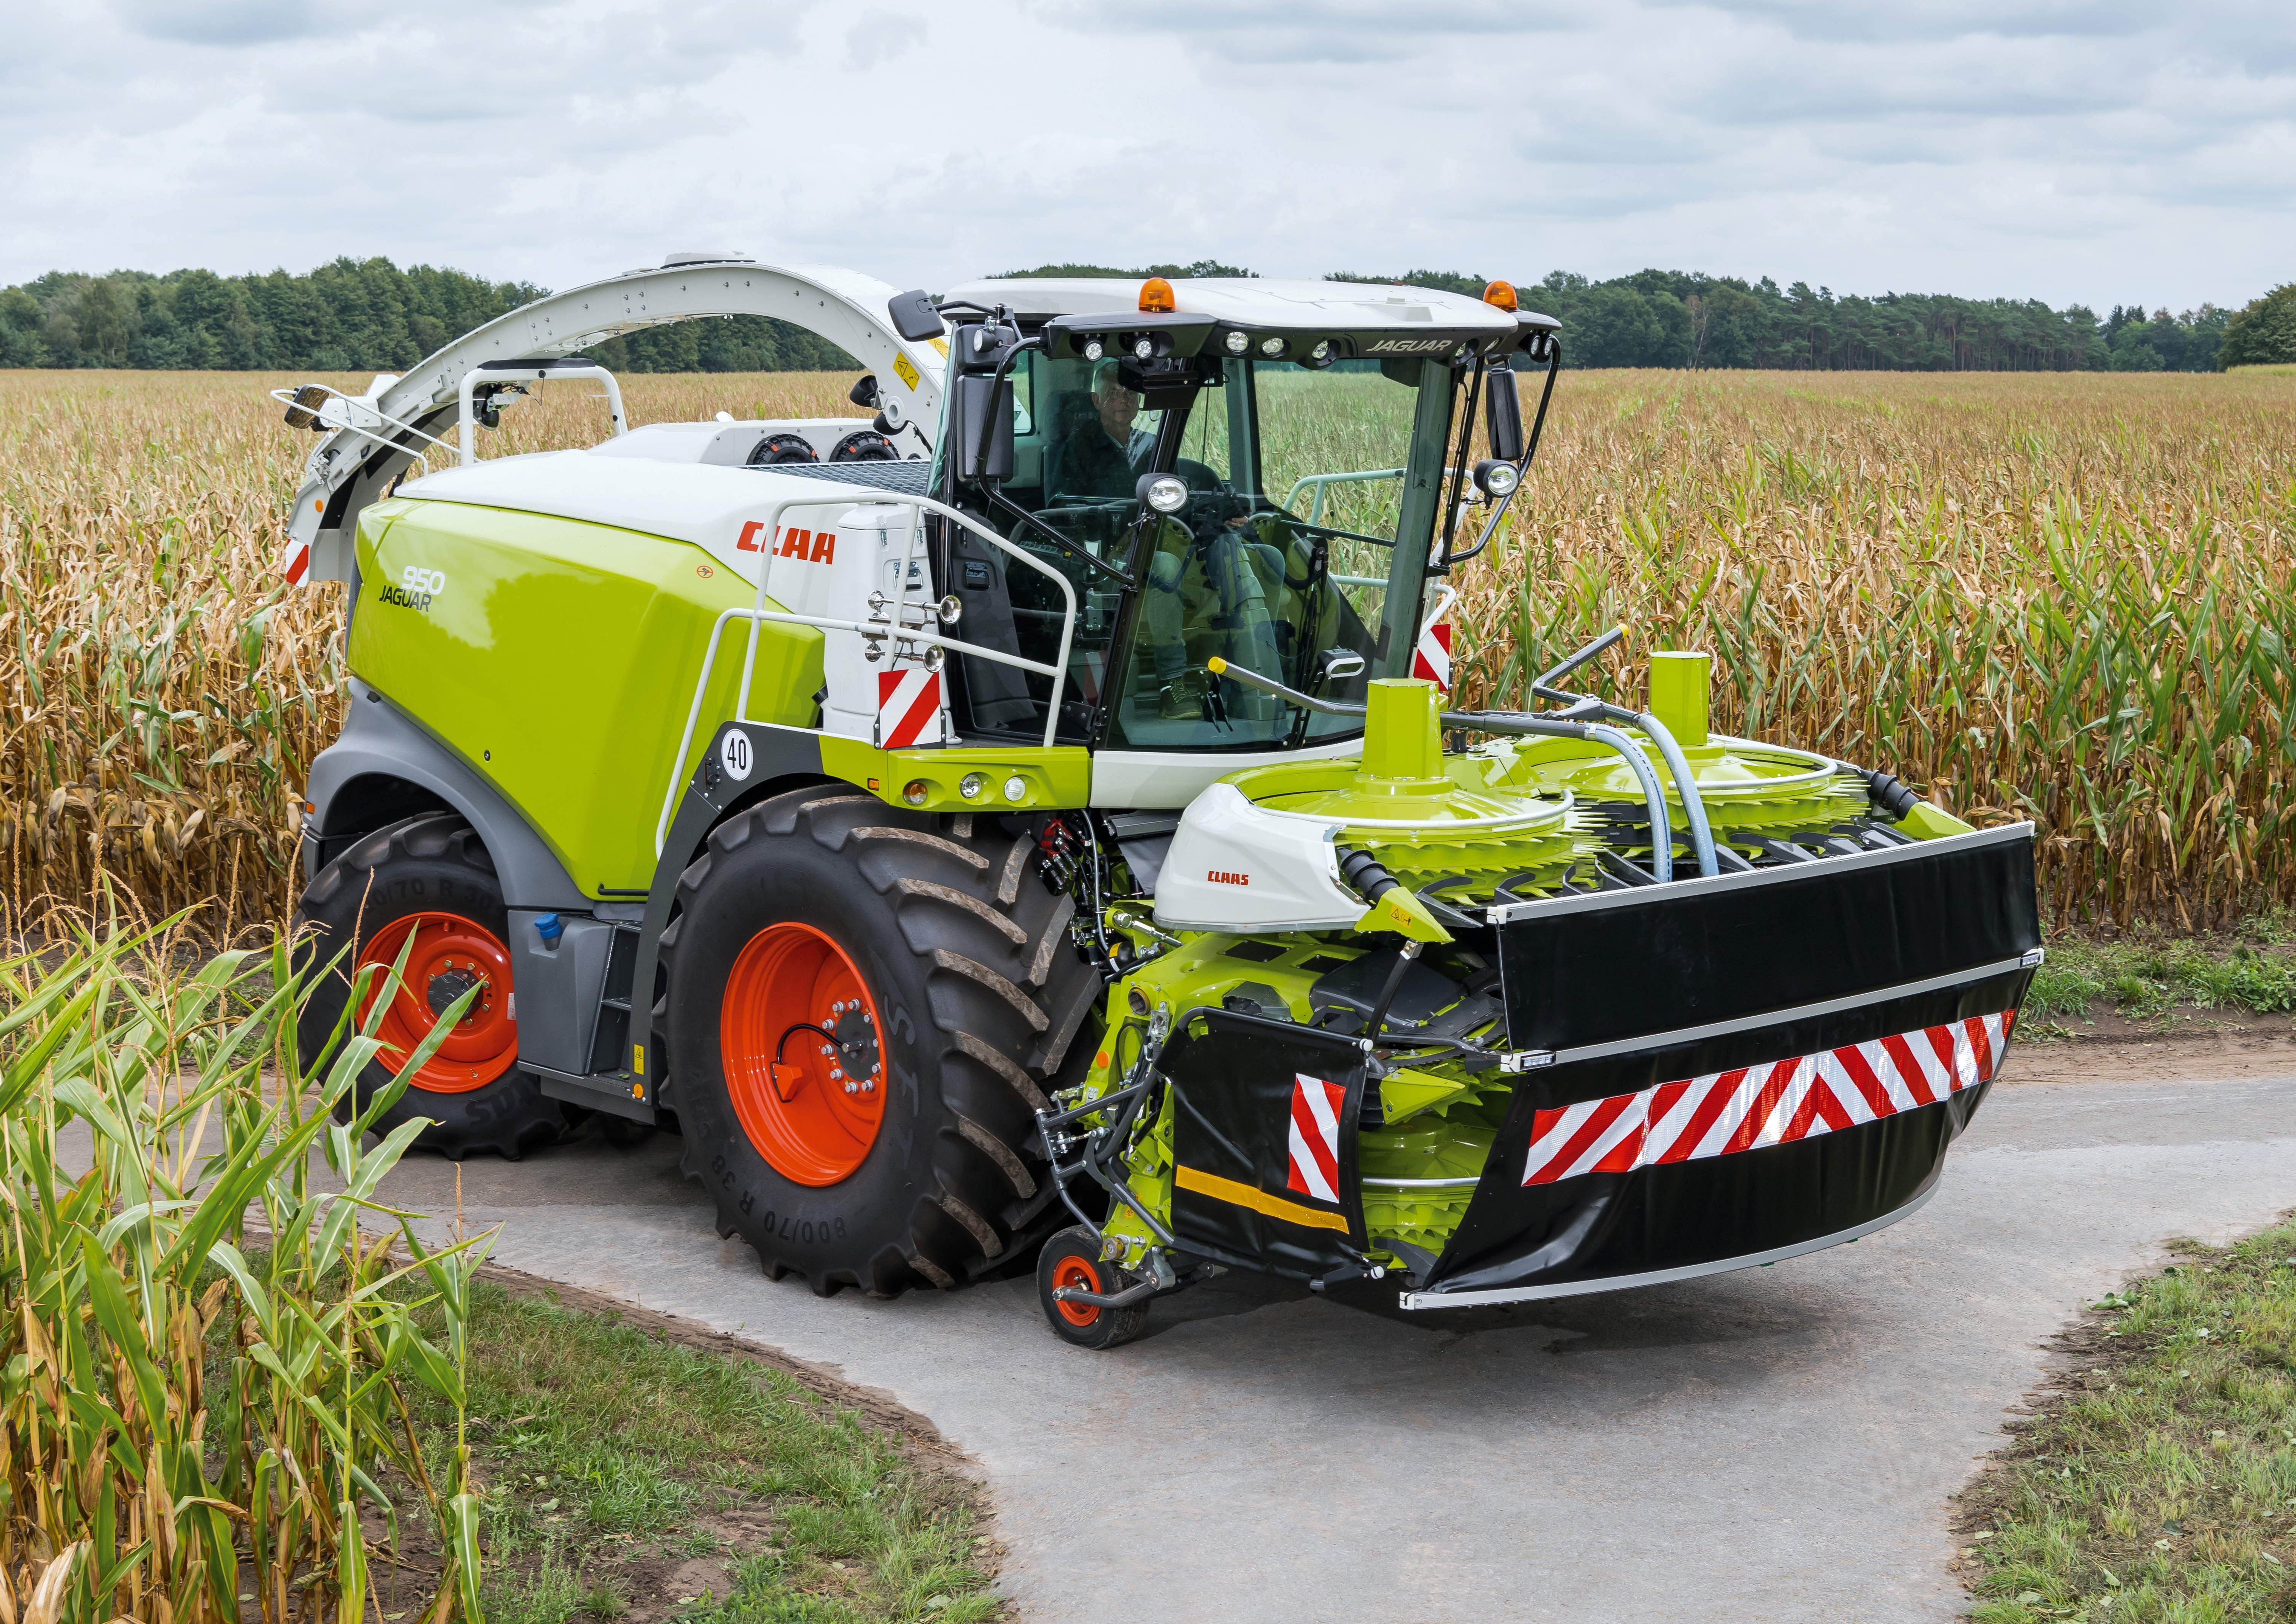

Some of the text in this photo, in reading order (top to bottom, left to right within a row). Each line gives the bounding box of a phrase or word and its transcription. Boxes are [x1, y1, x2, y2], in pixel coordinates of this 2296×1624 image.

[1365, 340, 1452, 351] JAGUAR
[737, 521, 836, 565] CAA
[401, 565, 445, 595] 950
[379, 585, 432, 612] JAGUAR
[727, 738, 747, 770] 40
[439, 878, 454, 897] R
[464, 886, 494, 909] 30
[1208, 871, 1249, 886] CLAAS
[711, 1154, 847, 1244] 800/70 R 38
